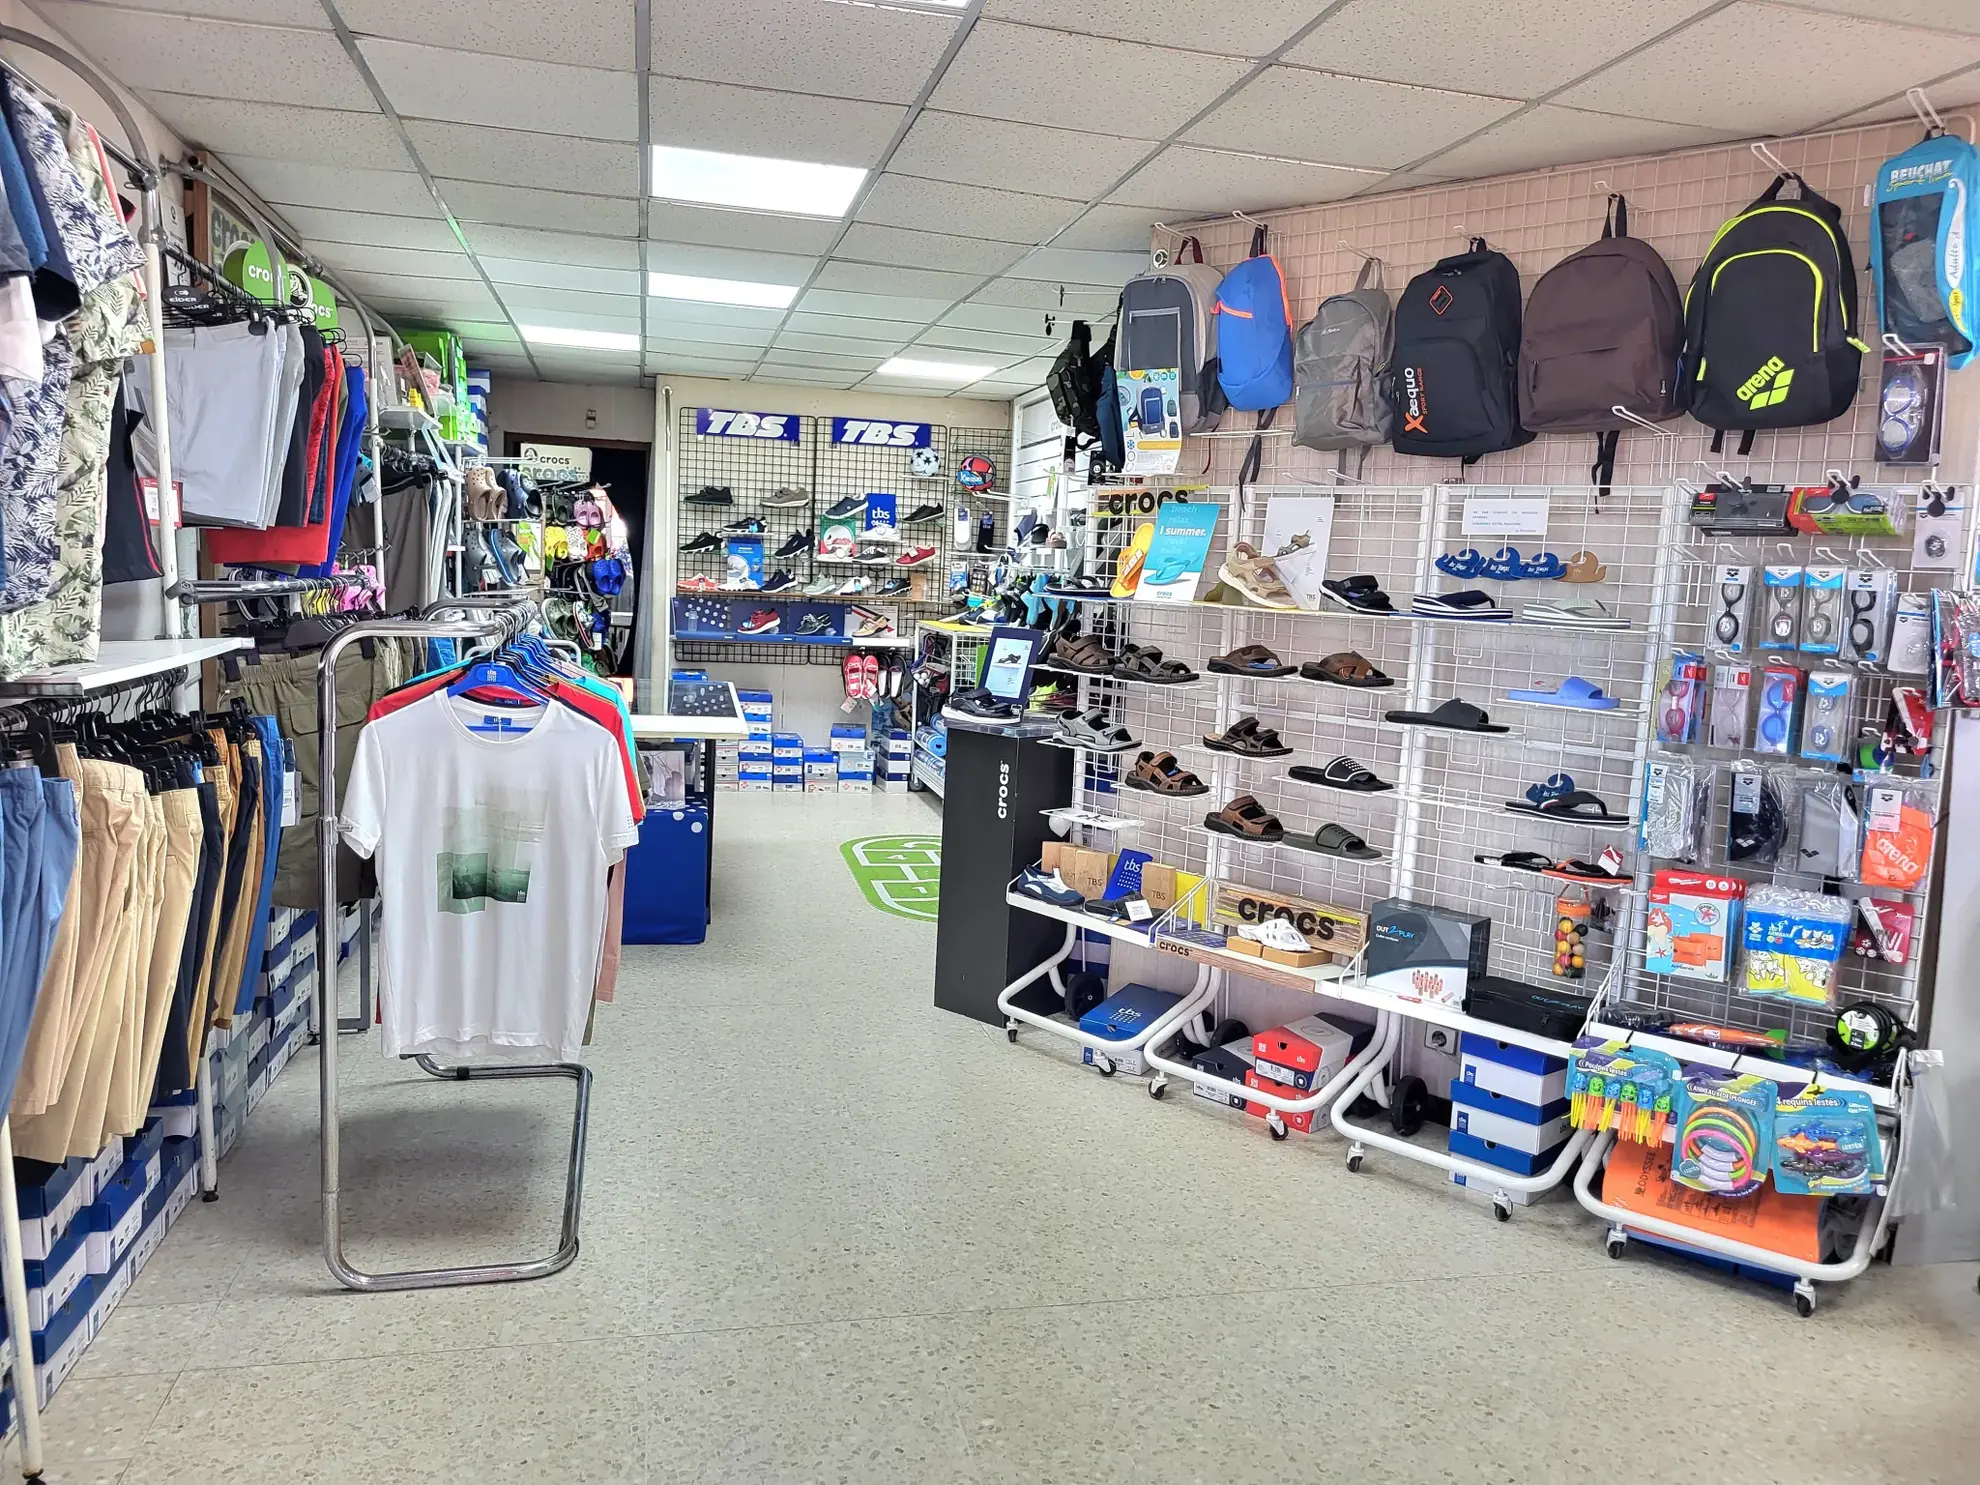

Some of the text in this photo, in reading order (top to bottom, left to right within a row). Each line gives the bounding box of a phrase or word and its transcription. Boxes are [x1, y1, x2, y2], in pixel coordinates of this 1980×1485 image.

[248, 265, 274, 282] cro
[1736, 356, 1785, 401] arena
[706, 411, 788, 438] TBS
[841, 420, 920, 447] TBS
[540, 455, 570, 465] crocs
[1109, 490, 1189, 515] crocs
[872, 506, 890, 520] tbs
[1160, 525, 1207, 537] I summer.
[998, 762, 1010, 819] crocs
[1123, 857, 1141, 873] tbs
[1087, 877, 1104, 887] TBS
[1151, 890, 1167, 901] TBS
[1238, 897, 1336, 941] crocs
[1159, 940, 1190, 957] crocs
[1782, 1098, 1812, 1108] requins
